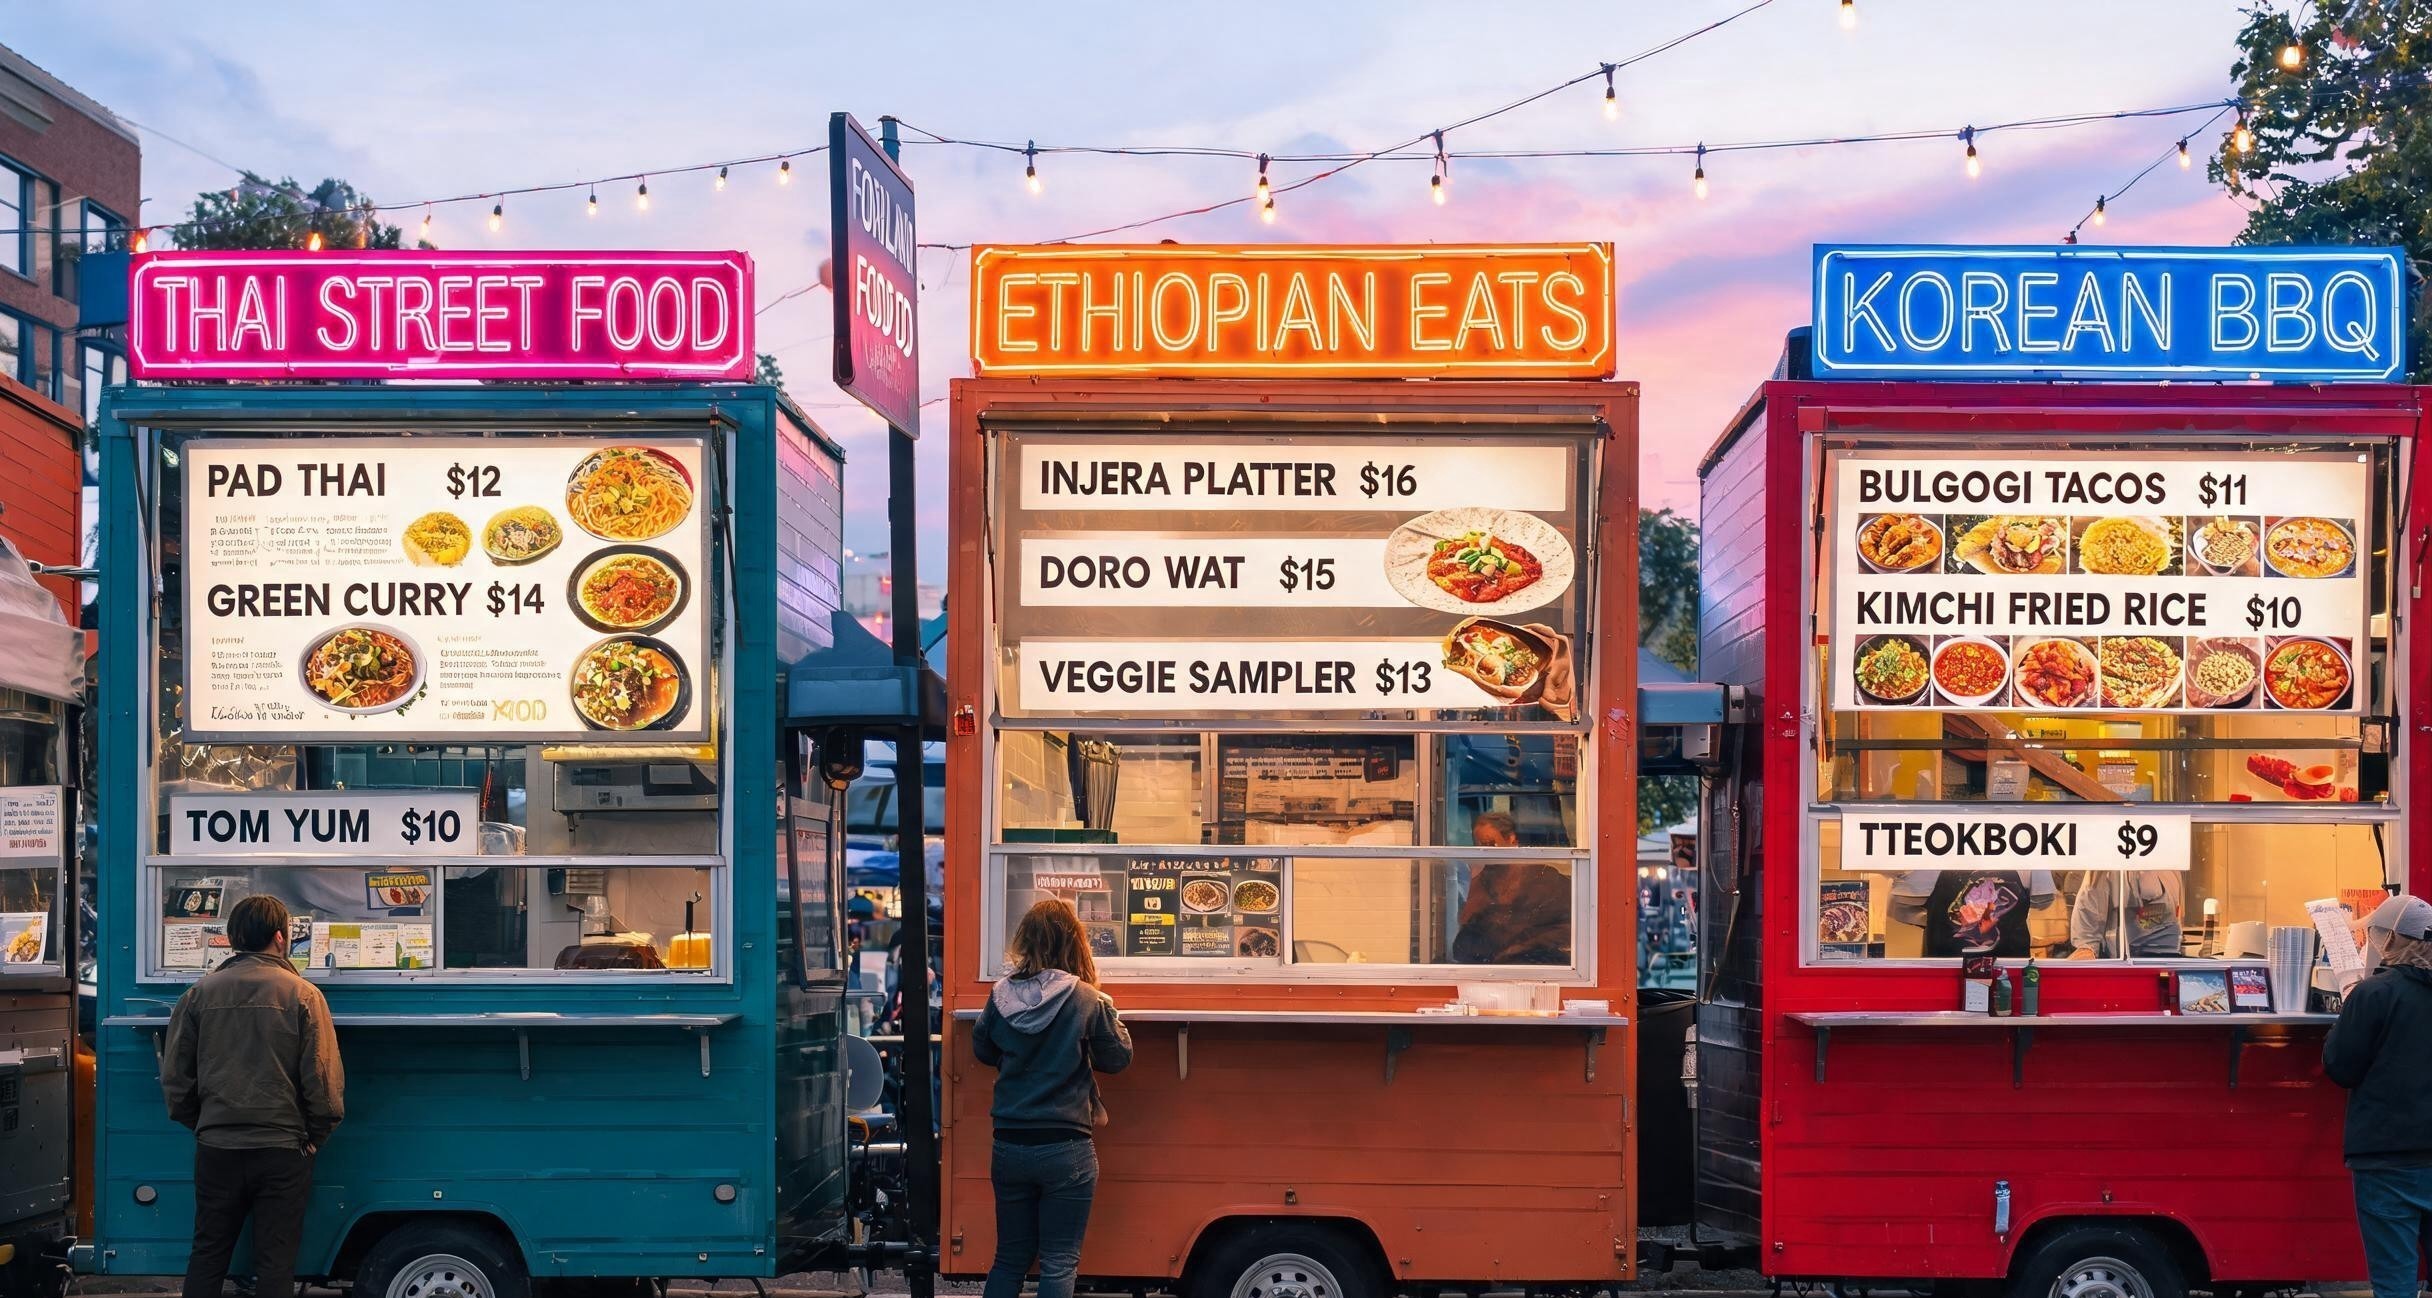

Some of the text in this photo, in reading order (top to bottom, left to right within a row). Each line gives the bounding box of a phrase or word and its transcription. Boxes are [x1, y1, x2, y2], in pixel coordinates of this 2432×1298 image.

[153, 275, 729, 351] THAI STREET FOOD
[999, 271, 1587, 352] ETHIOPIAN EATS
[1843, 270, 2380, 361] KOREAN BBQ
[208, 462, 502, 500] PAD THAI $12
[1041, 460, 1417, 499] INJERA PLATTER $16
[1859, 469, 2247, 509] BULGOGI TACOS $11
[1040, 555, 1335, 594] DORO WAT $15
[207, 580, 545, 618] GREEN CURRY $14
[1857, 591, 2302, 632] KIMCHI FRIED RICE $10
[1039, 657, 1432, 697] VEGGIE SAMPLER $13
[185, 807, 461, 846] TOM YUM $10
[1859, 820, 2158, 860] TTEOKBOKI $9
